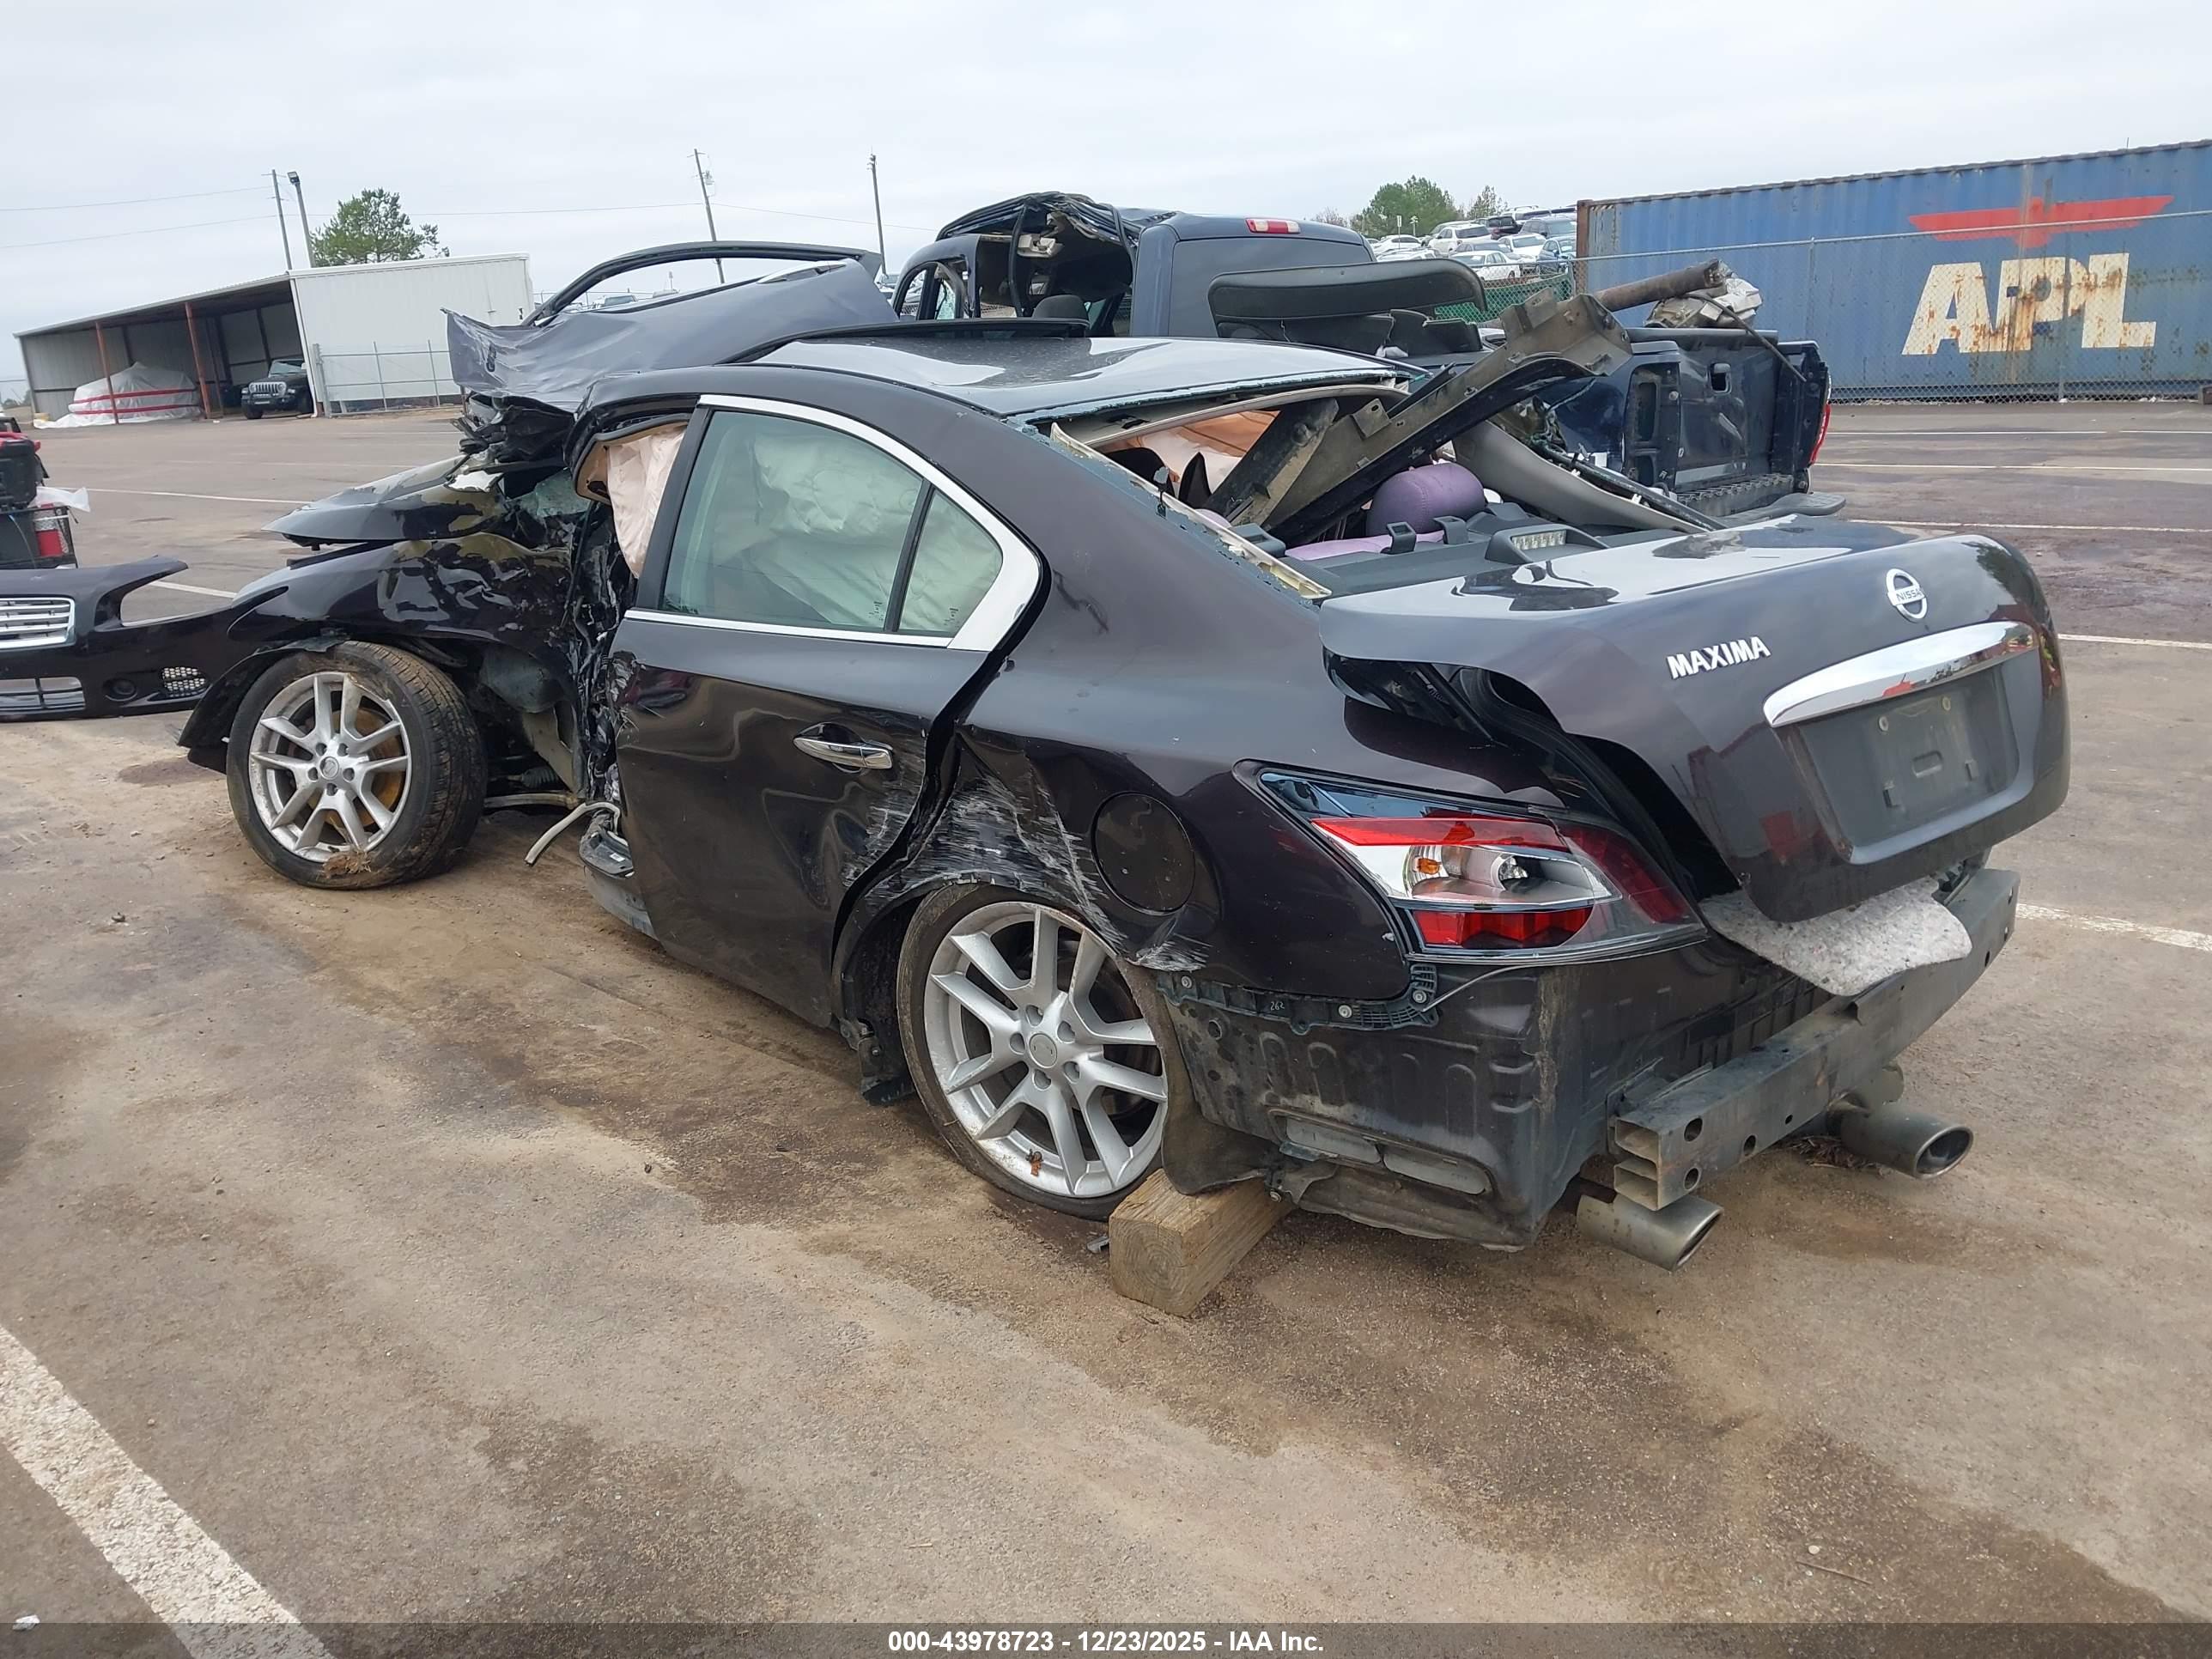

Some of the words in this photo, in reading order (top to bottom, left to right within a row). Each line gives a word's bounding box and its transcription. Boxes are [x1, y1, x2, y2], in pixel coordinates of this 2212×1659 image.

[1902, 253, 2156, 355] APL
[1895, 588, 1924, 602] NISSA
[1667, 635, 1771, 679] MAXIMA
